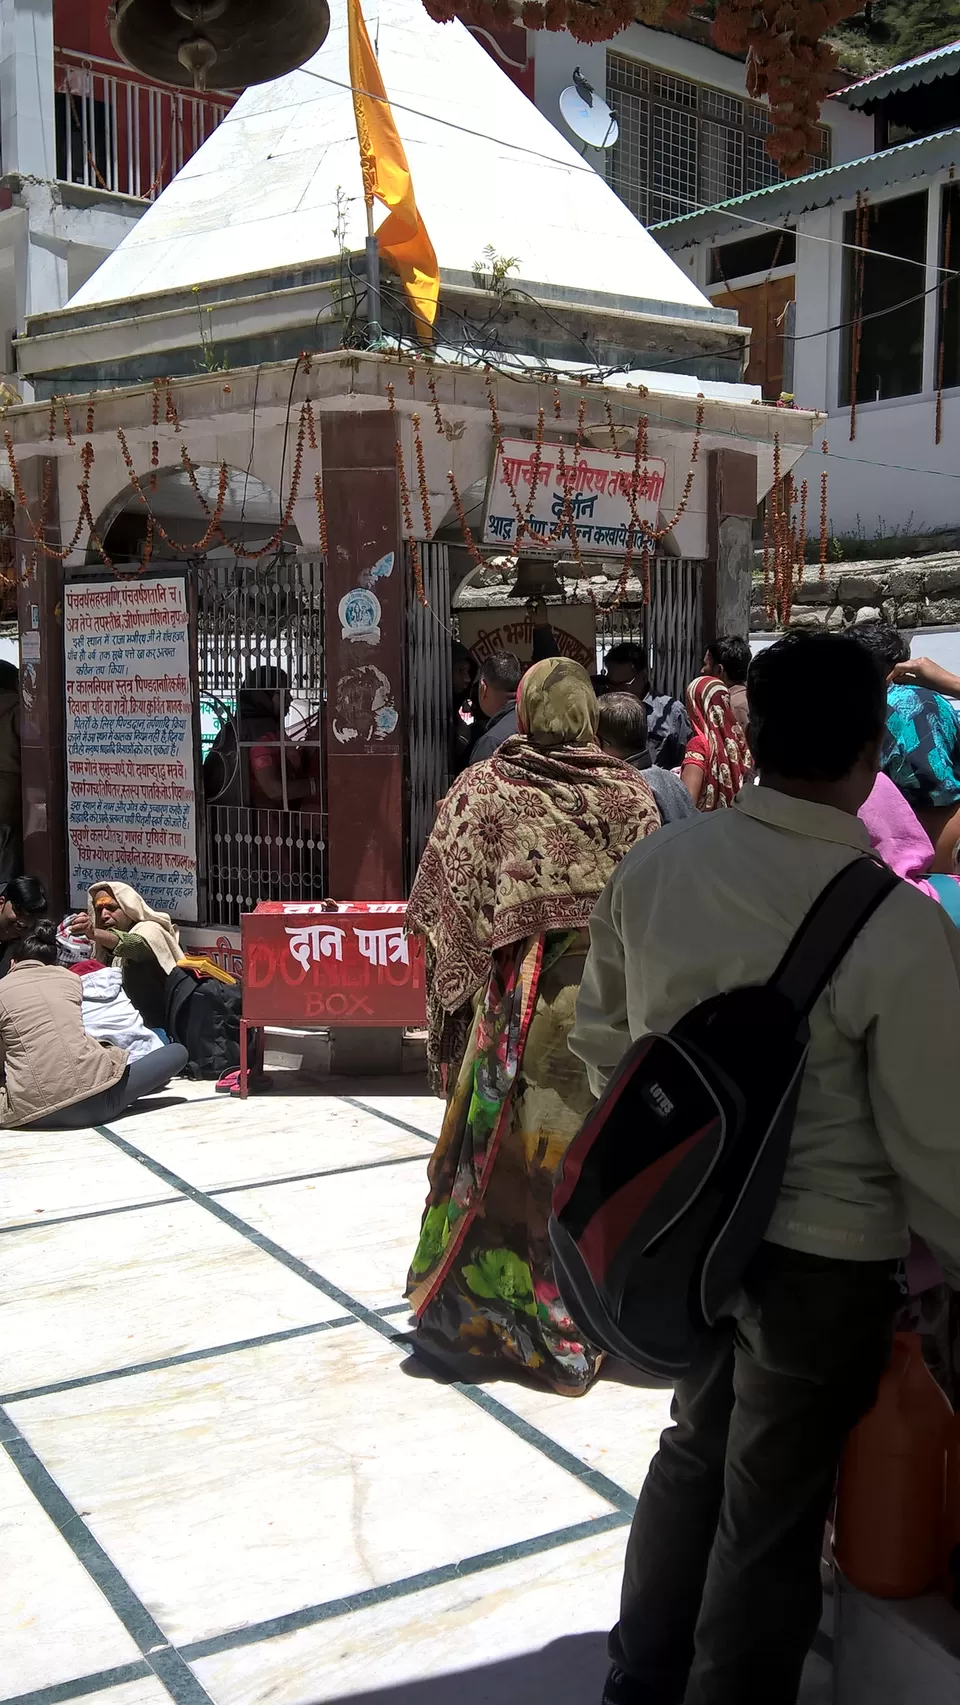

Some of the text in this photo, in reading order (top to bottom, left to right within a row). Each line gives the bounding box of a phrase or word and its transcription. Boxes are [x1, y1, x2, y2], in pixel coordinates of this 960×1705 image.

[284, 924, 346, 973] दान
[352, 926, 410, 967] पात्र
[303, 991, 376, 1017] BOX
